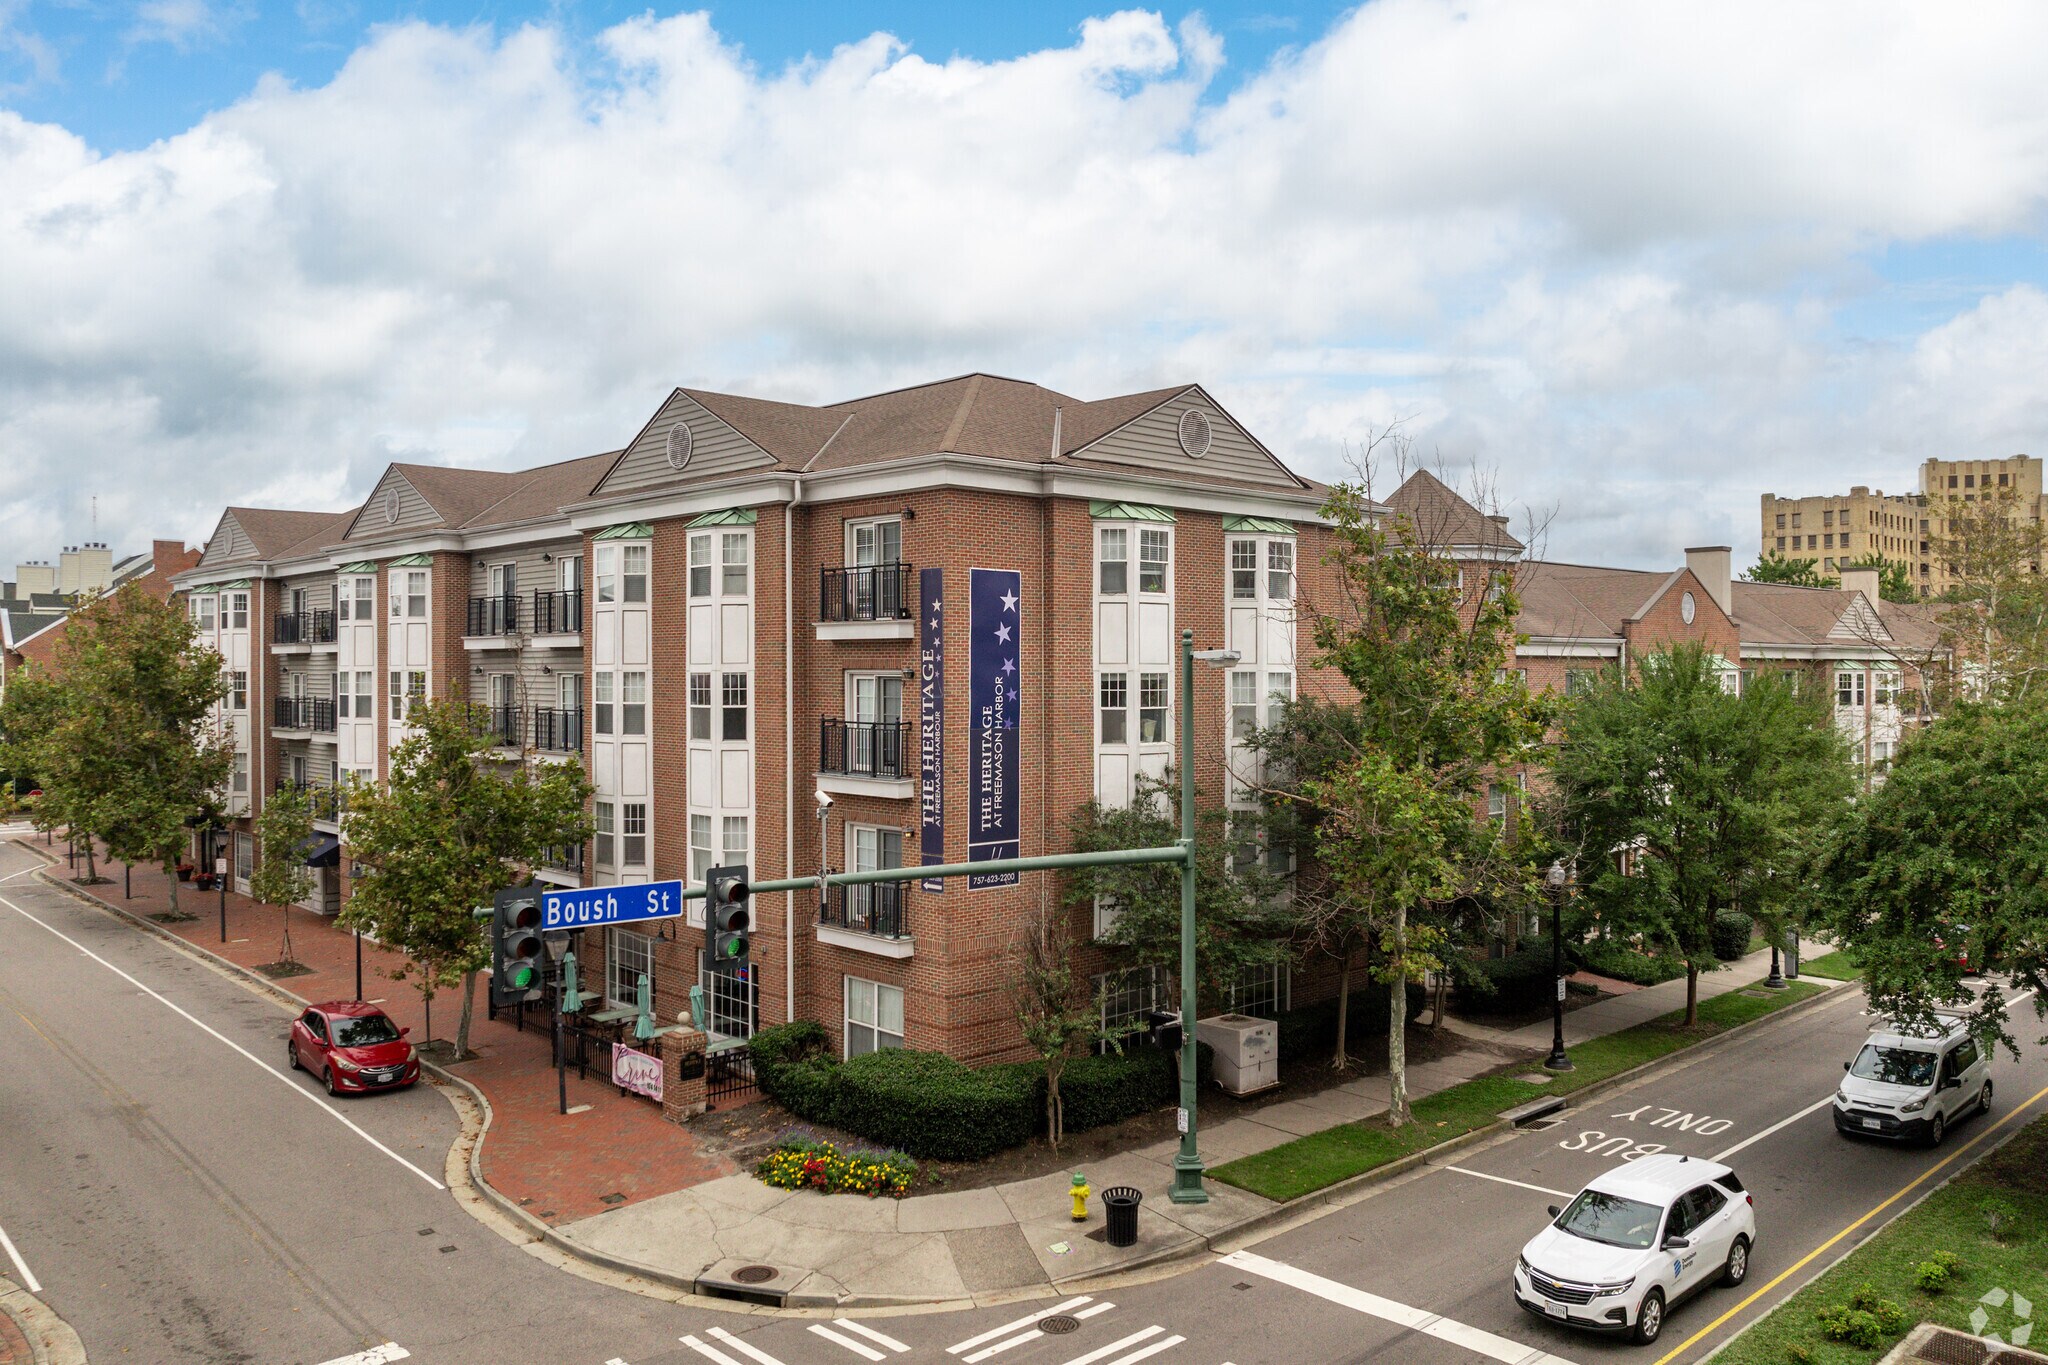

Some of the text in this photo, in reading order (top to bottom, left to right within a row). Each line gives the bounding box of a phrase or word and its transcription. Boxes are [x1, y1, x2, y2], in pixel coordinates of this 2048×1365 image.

[922, 649, 934, 827] THE HERITAGE
[993, 676, 1004, 828] AT FREEMASON HARBOR
[981, 706, 993, 831] THE HERITAGE
[935, 815, 941, 827] AT
[973, 872, 1015, 885] 757-623-2200
[547, 889, 670, 925] Boush St
[1611, 1105, 1734, 1136] ONLY
[1559, 1131, 1668, 1162] BUS
